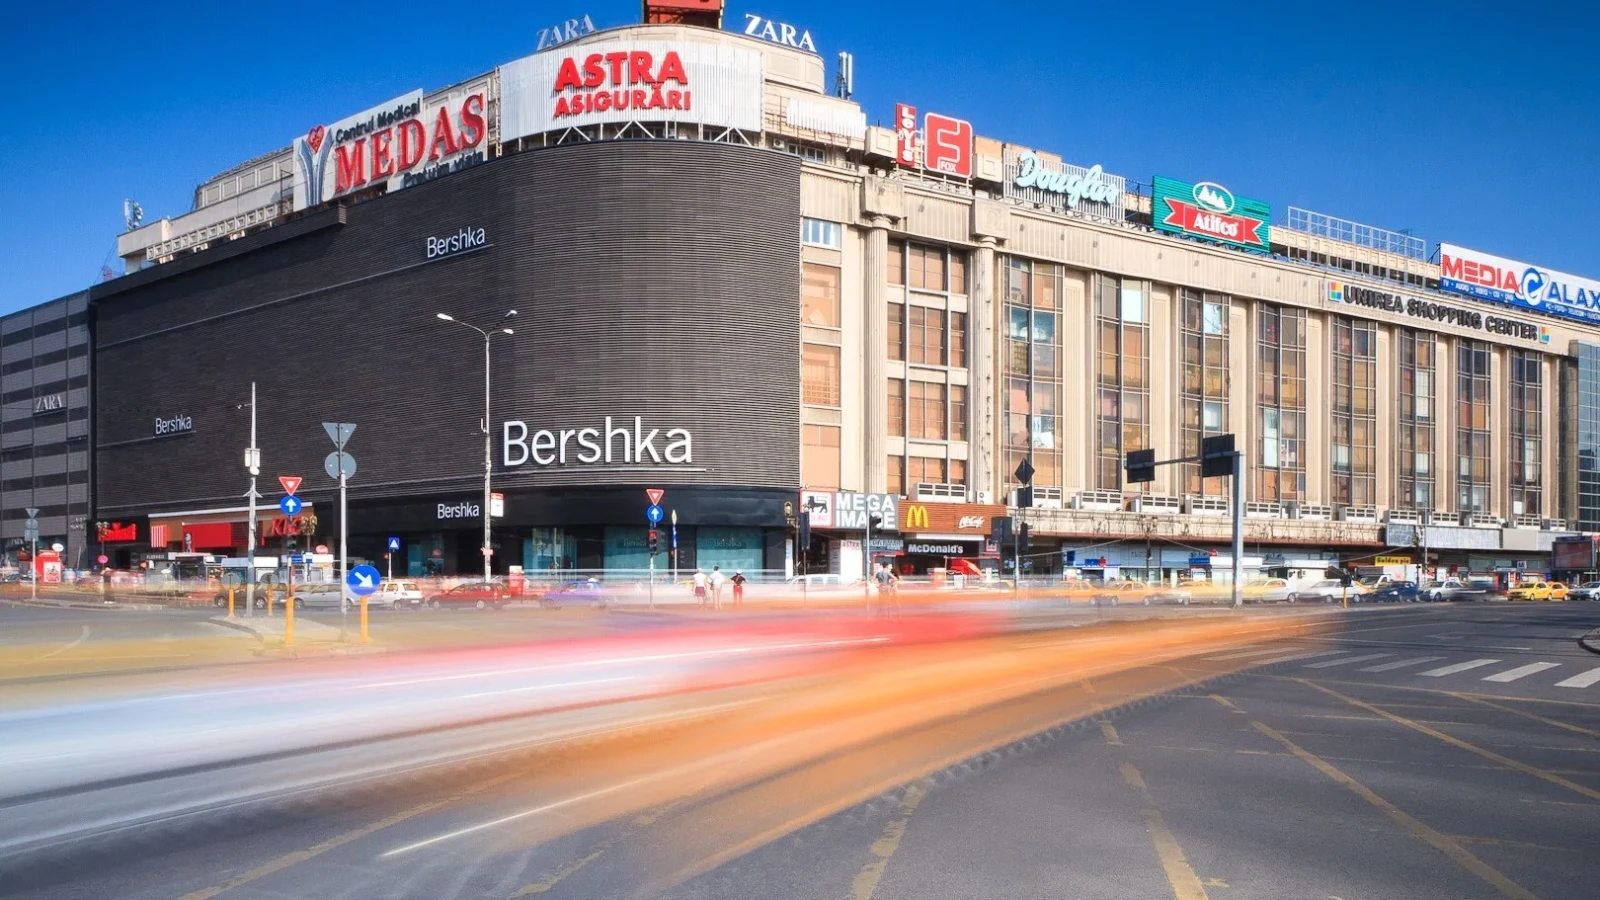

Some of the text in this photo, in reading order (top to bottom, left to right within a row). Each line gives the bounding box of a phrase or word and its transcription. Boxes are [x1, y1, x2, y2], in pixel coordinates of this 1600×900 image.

[536, 14, 597, 51] ZARA
[744, 14, 817, 53] ZARA
[554, 51, 689, 92] ASTRA
[335, 97, 421, 143] Centrul Medical
[553, 85, 692, 118] ASIGURĂRI
[334, 93, 486, 194] MEDAS
[939, 161, 957, 173] FOX
[1016, 151, 1119, 207] Douglas
[427, 226, 486, 258] Bershka
[1442, 254, 1519, 294] MEDIA
[1343, 284, 1538, 341] UNIREA SHOPPING CENTER
[35, 394, 64, 413] ZARA
[155, 413, 193, 435] Bershka
[503, 416, 693, 467] Bershka
[437, 502, 480, 520] Bershka
[835, 492, 896, 512] MEGA
[908, 544, 964, 554] McDonald's
